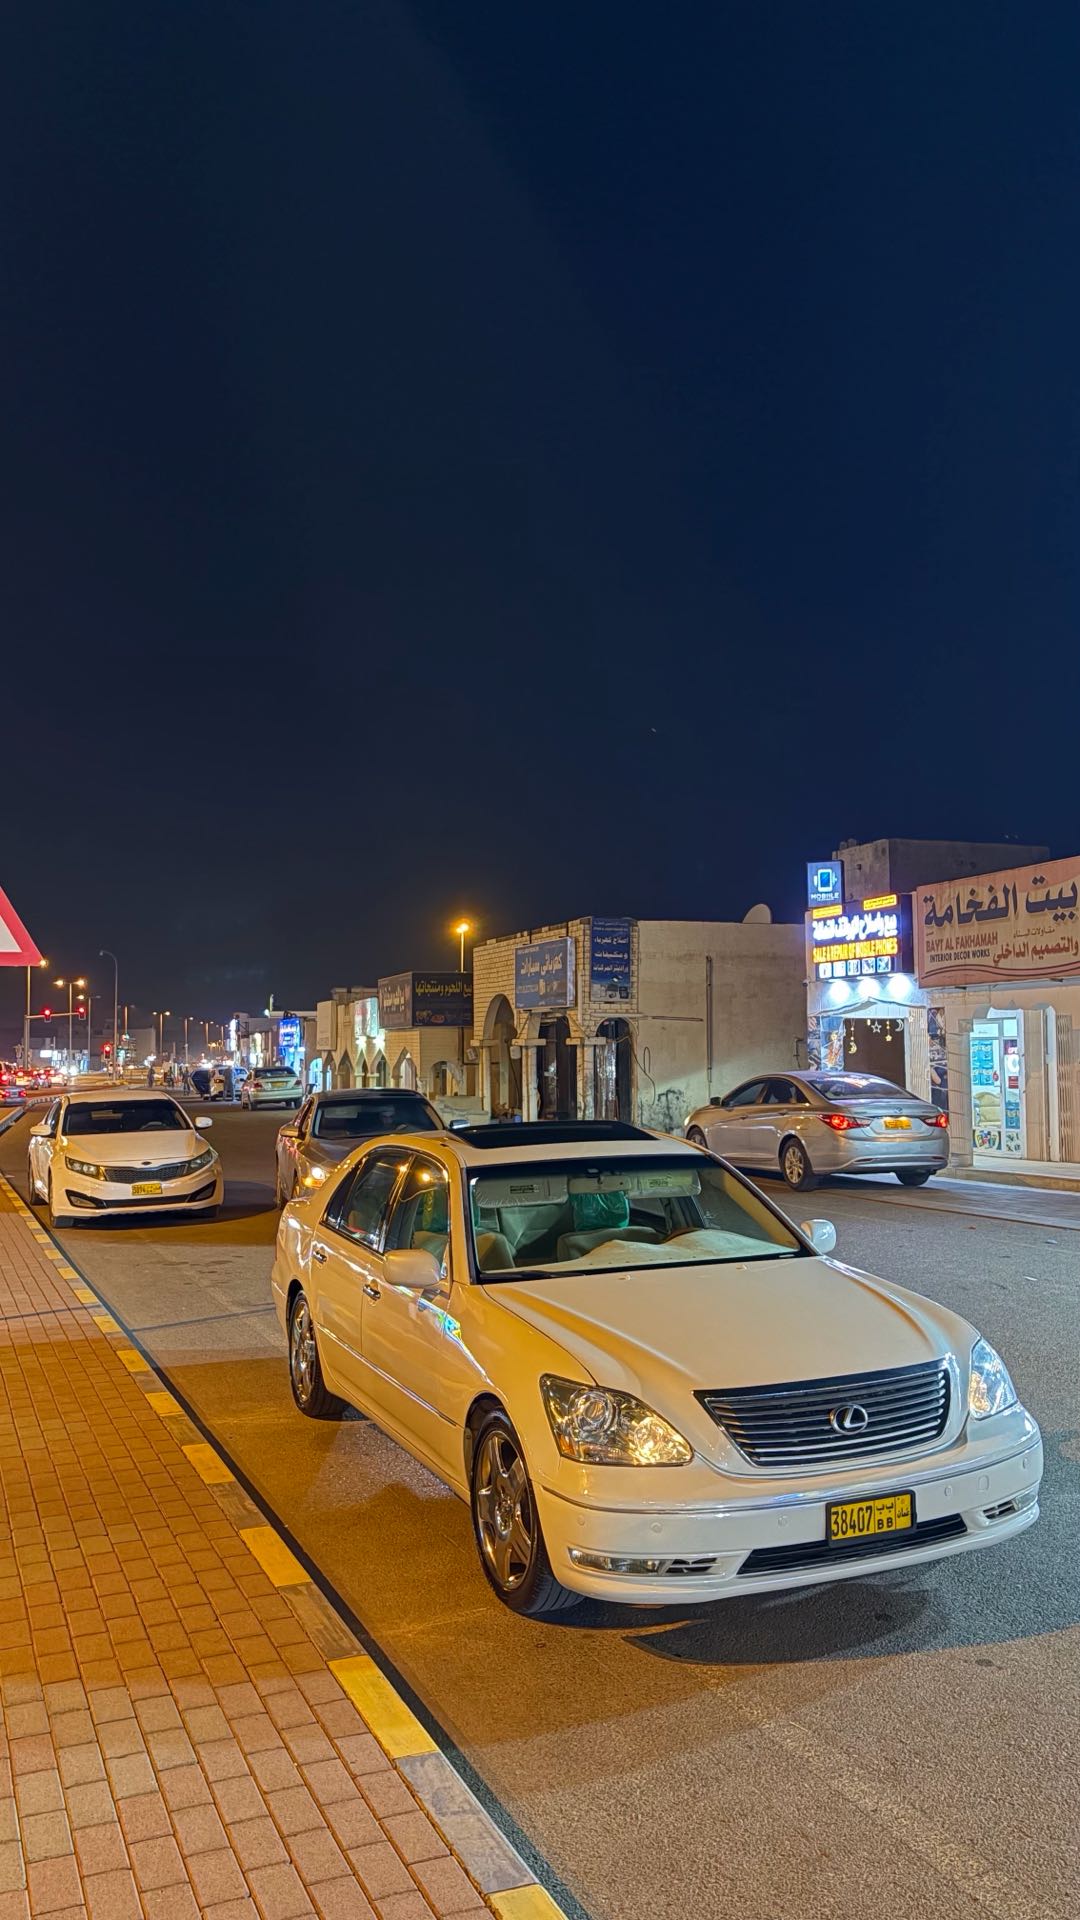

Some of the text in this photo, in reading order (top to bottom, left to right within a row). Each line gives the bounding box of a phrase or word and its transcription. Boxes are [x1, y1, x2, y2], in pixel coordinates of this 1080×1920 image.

[923, 875, 1078, 927] بيت الفخامة
[813, 946, 827, 963] SALE
[925, 931, 998, 953] BAYT AL FAKHAMAH
[992, 935, 1079, 966] والتصميم الداخلي
[929, 948, 991, 963] INTERIOR DECOR WORKS
[832, 1505, 873, 1537] 38407
